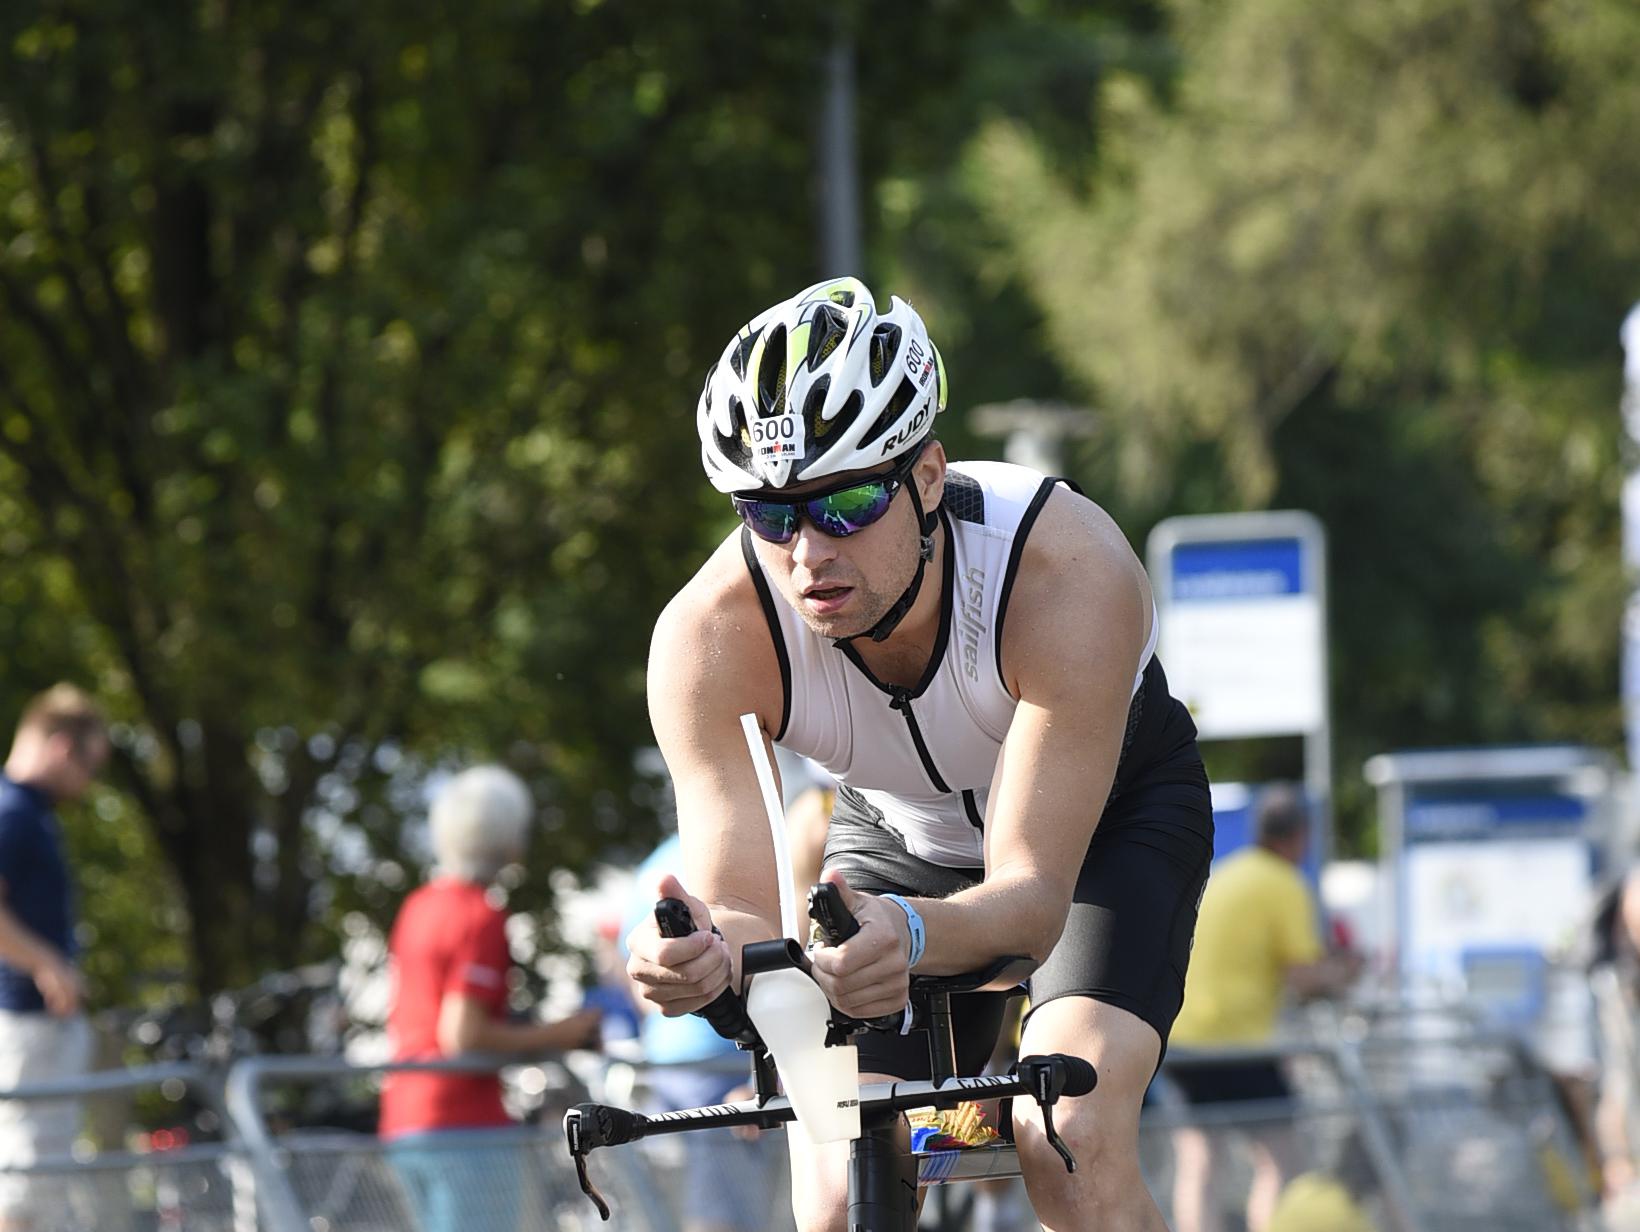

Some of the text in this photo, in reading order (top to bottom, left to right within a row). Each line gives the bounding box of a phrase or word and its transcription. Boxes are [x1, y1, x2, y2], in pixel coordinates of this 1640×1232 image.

[906, 339, 924, 374] 600
[753, 417, 794, 442] 600
[881, 396, 931, 456] RUDY
[958, 567, 986, 683] sailfish
[958, 1073, 1019, 1091] CANY
